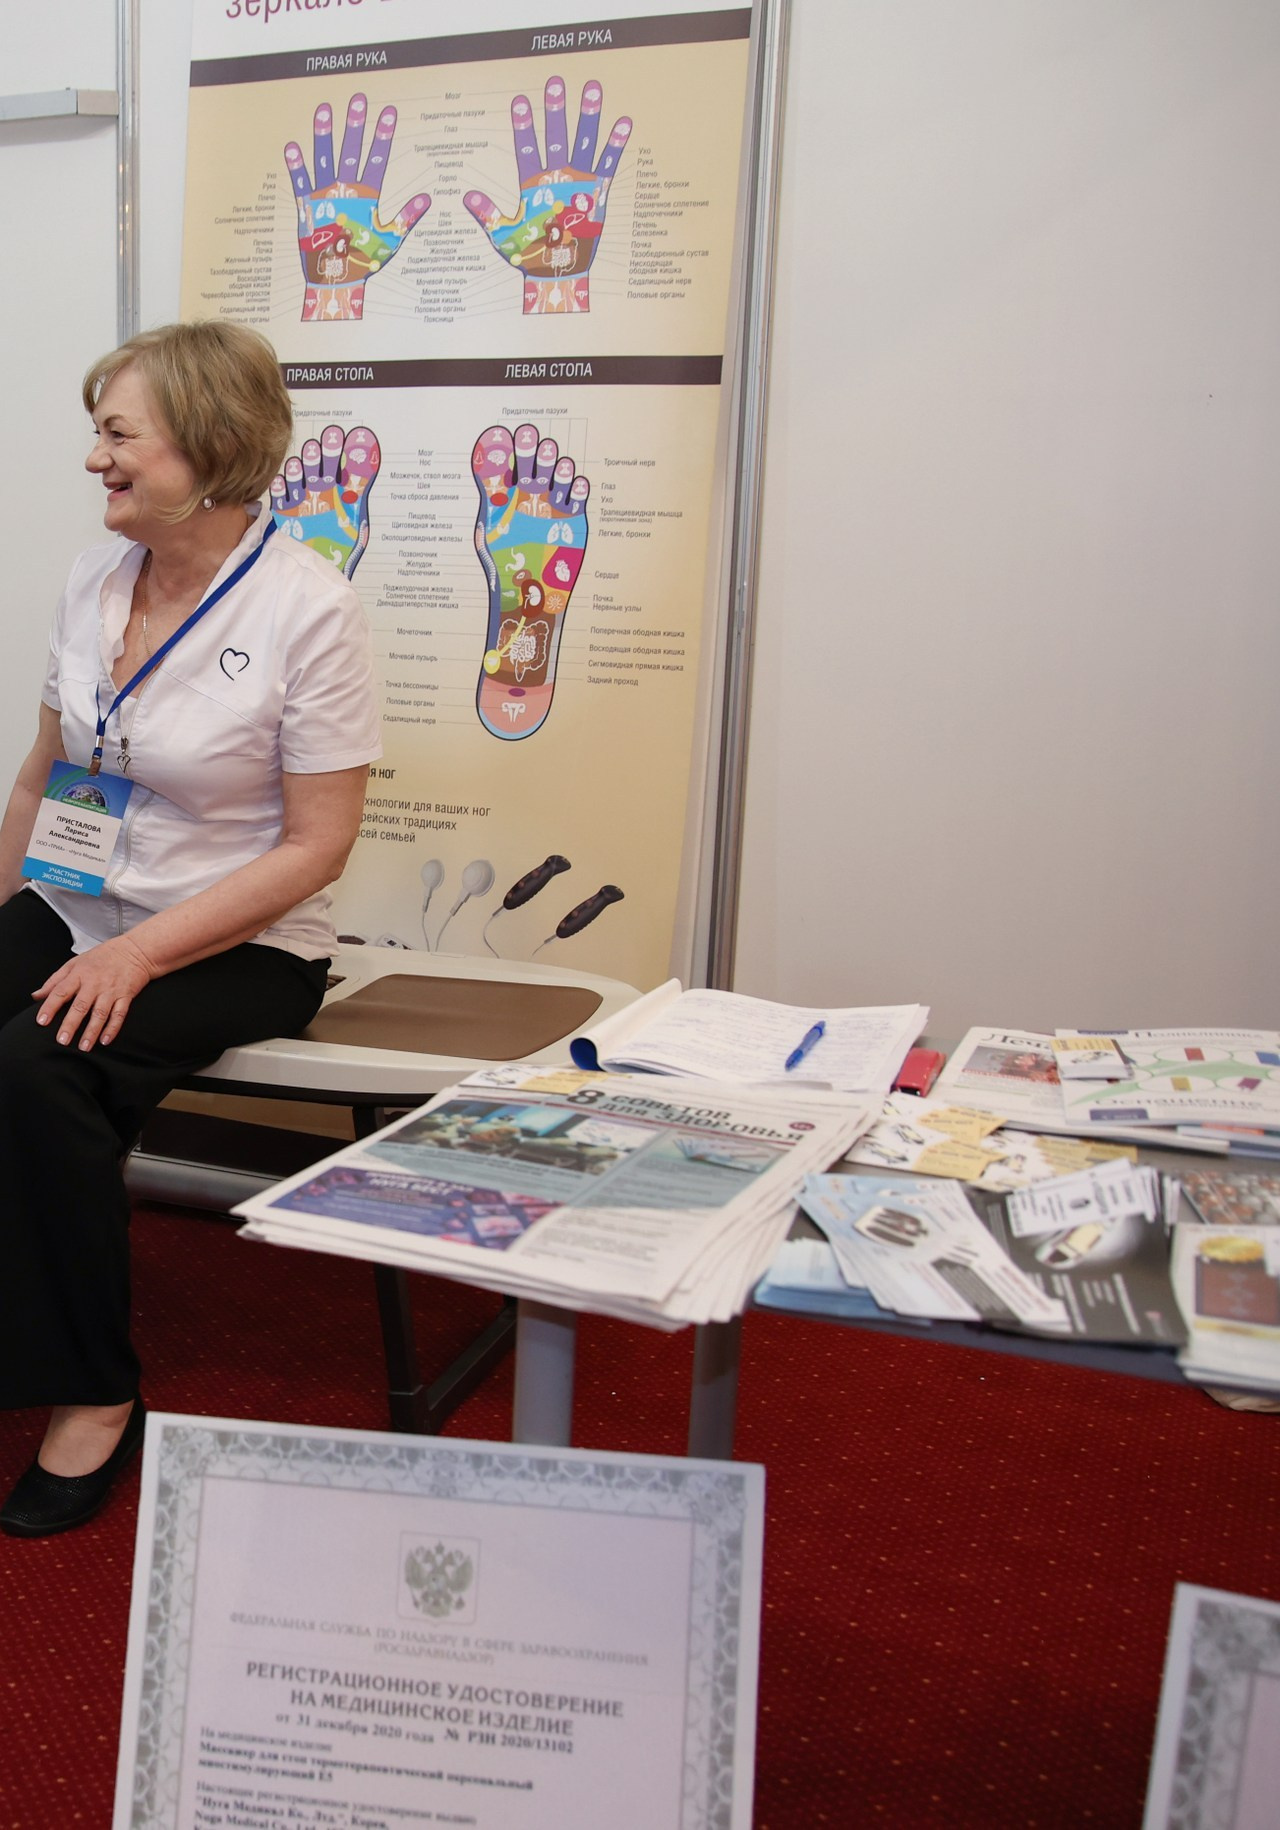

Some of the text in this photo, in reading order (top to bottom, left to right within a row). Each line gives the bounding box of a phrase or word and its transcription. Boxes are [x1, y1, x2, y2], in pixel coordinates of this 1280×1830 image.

[226, 0, 362, 24] зерк
[530, 29, 613, 51] ЛЕВАЯ РУКА
[306, 50, 388, 71] ПРАВАЯ РУКА
[445, 92, 461, 100] Мозг
[420, 110, 486, 121] Придаточные пазухи
[639, 147, 651, 155] Ухо
[637, 158, 654, 167] Рука
[636, 170, 658, 178] Плечо
[663, 181, 690, 189] бронхи
[634, 192, 660, 200] Сердце
[634, 200, 710, 209] Солнечное сплетение
[633, 210, 683, 219] Надпочечники
[632, 220, 657, 229] Печень
[631, 229, 668, 237] Селезенка
[630, 240, 652, 248] Почка
[631, 250, 710, 258] Тазобедренный сустав
[629, 260, 673, 268] Нисходящая
[400, 266, 464, 275] Двенадцатиперстная
[628, 267, 658, 275] ободная
[444, 278, 468, 286] пузырь
[628, 277, 692, 286] Седалищный нерв
[626, 290, 686, 299] Половые органы
[286, 366, 375, 383] ПРАВАЯ СТОПА
[505, 361, 593, 379] ЛЕВАЯ СТОПА
[332, 409, 353, 418] пазухи
[502, 406, 568, 416] Придаточные пазухи
[604, 458, 638, 467] Троичный
[601, 482, 616, 490] Глаз
[407, 493, 428, 501] сброса
[600, 495, 613, 503] Ухо
[408, 512, 436, 520] Пищевод
[600, 508, 656, 517] Трапециевидная
[391, 521, 429, 529] Щитовидная
[381, 534, 437, 542] Околощитовидные
[625, 530, 651, 538] бронхи
[398, 550, 438, 558] Позвоночник
[405, 560, 432, 568] Желудок
[397, 568, 440, 576] Надпочечники
[594, 570, 619, 579] Сердце
[383, 584, 429, 592] Поджелудочная
[385, 592, 417, 600] Солнечное
[593, 594, 613, 602] Почка
[376, 599, 437, 608] Двенадцатиперстная
[592, 603, 642, 613] Нервные узлы
[396, 628, 432, 636] Мочеточник
[590, 626, 685, 638] Поперечная ободная кишка
[589, 644, 685, 656] Восходящая ободная кишка
[388, 652, 438, 662] Мочевой пузырь
[588, 659, 633, 669] Сигмовидная
[635, 662, 660, 670] прямая
[385, 680, 439, 690] Точка бессонницы
[587, 675, 639, 686] Задний проход
[386, 697, 412, 706] Половые
[382, 714, 420, 723] Седалищный
[364, 797, 491, 817] хнологии для ваших ног
[56, 815, 102, 834] ПРИСТАЛОВА
[361, 812, 458, 831] рейских традициях
[64, 826, 89, 838] Лариса
[48, 830, 101, 850] Александровна
[48, 866, 81, 880] УЧАСТНИК
[41, 872, 84, 889] ЭКСПОЗИЦИИ
[566, 1089, 605, 1105] 8
[229, 1612, 316, 1631] ФЕДЕРАЛЬНАЯ
[320, 1620, 371, 1637] СЛУЖБА
[376, 1628, 396, 1640] ПО
[246, 1661, 624, 1718] РЕГИСТРАЦИОННОЕ УДОСТОВЕРЕНИЕ
[291, 1690, 574, 1736] НА МЕДИЦИНСКОЕ ИЗДЕЛИЕ
[276, 1713, 289, 1723] от
[296, 1714, 310, 1726] 31
[315, 1717, 368, 1735] декабря
[372, 1724, 402, 1738] 2020
[405, 1731, 435, 1743] года
[444, 1728, 459, 1742] №
[501, 1734, 574, 1754] 2020/13102
